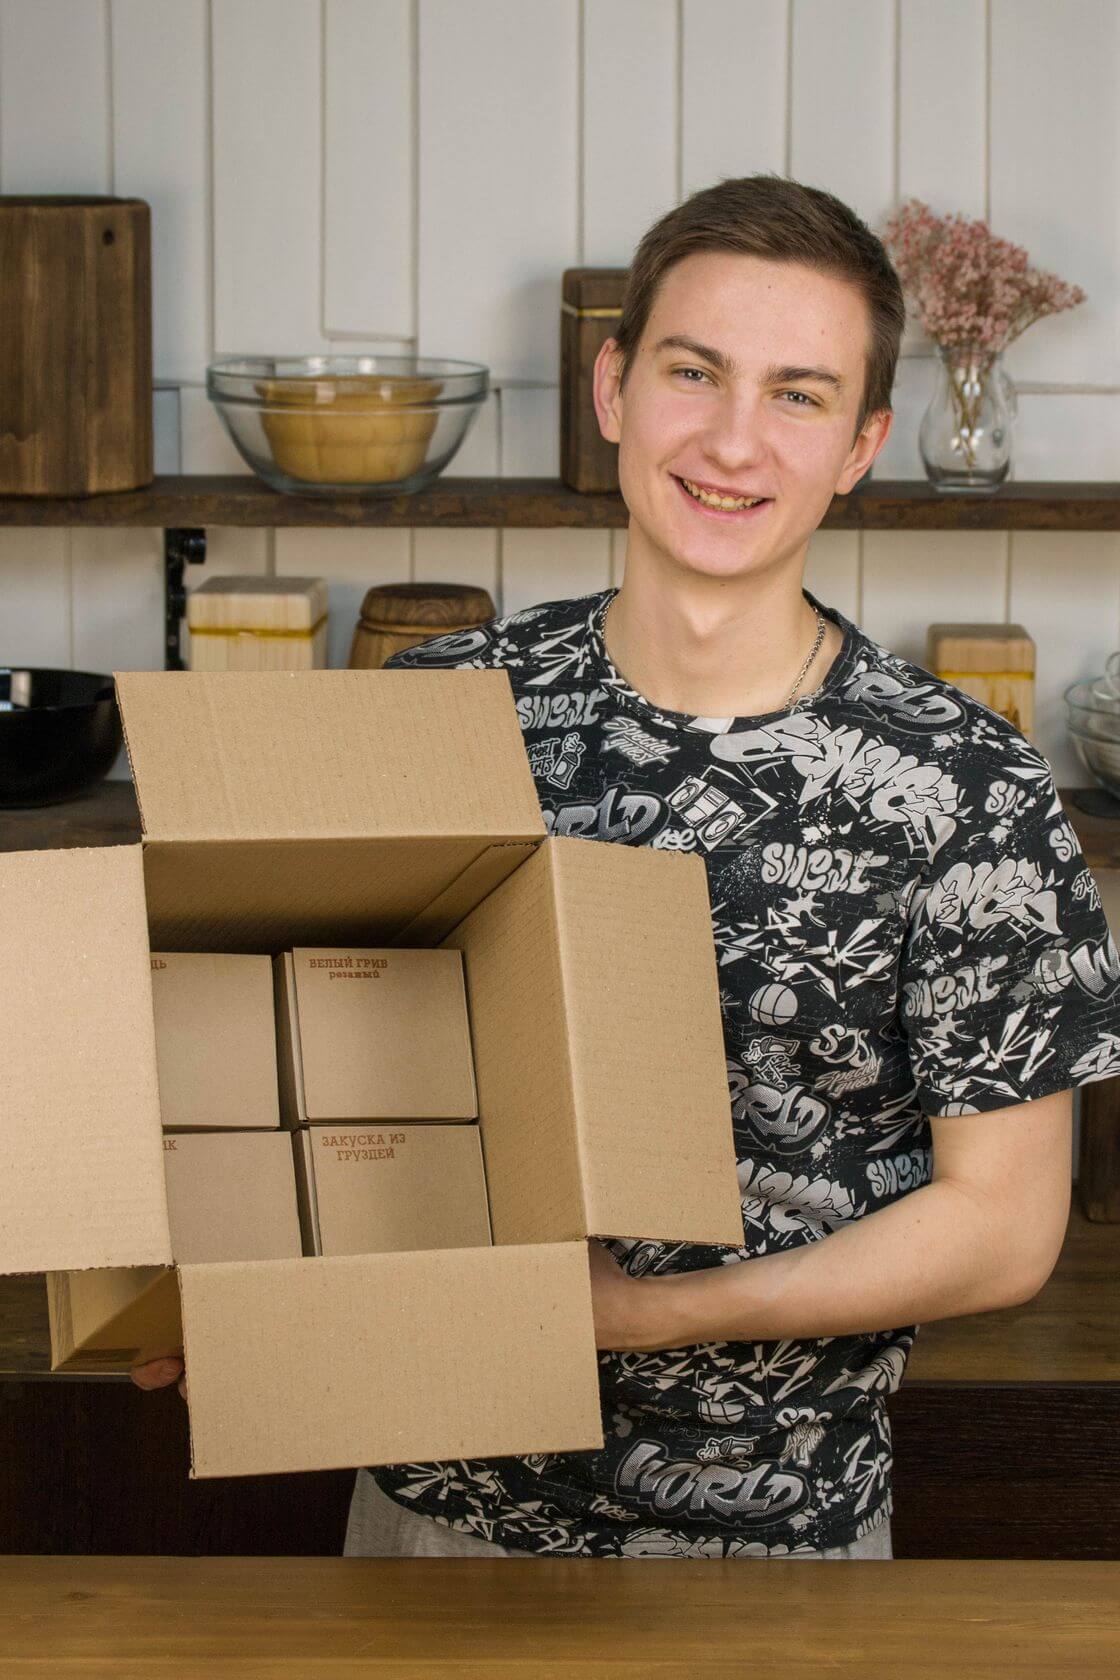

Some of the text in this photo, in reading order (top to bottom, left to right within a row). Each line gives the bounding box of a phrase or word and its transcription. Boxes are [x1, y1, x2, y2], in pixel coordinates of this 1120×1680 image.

[322, 1133, 406, 1148] ЗАКУСКА ИЗ
[336, 1147, 395, 1162] ГРУЗДЕЙ
[618, 1442, 804, 1521] WORLD
